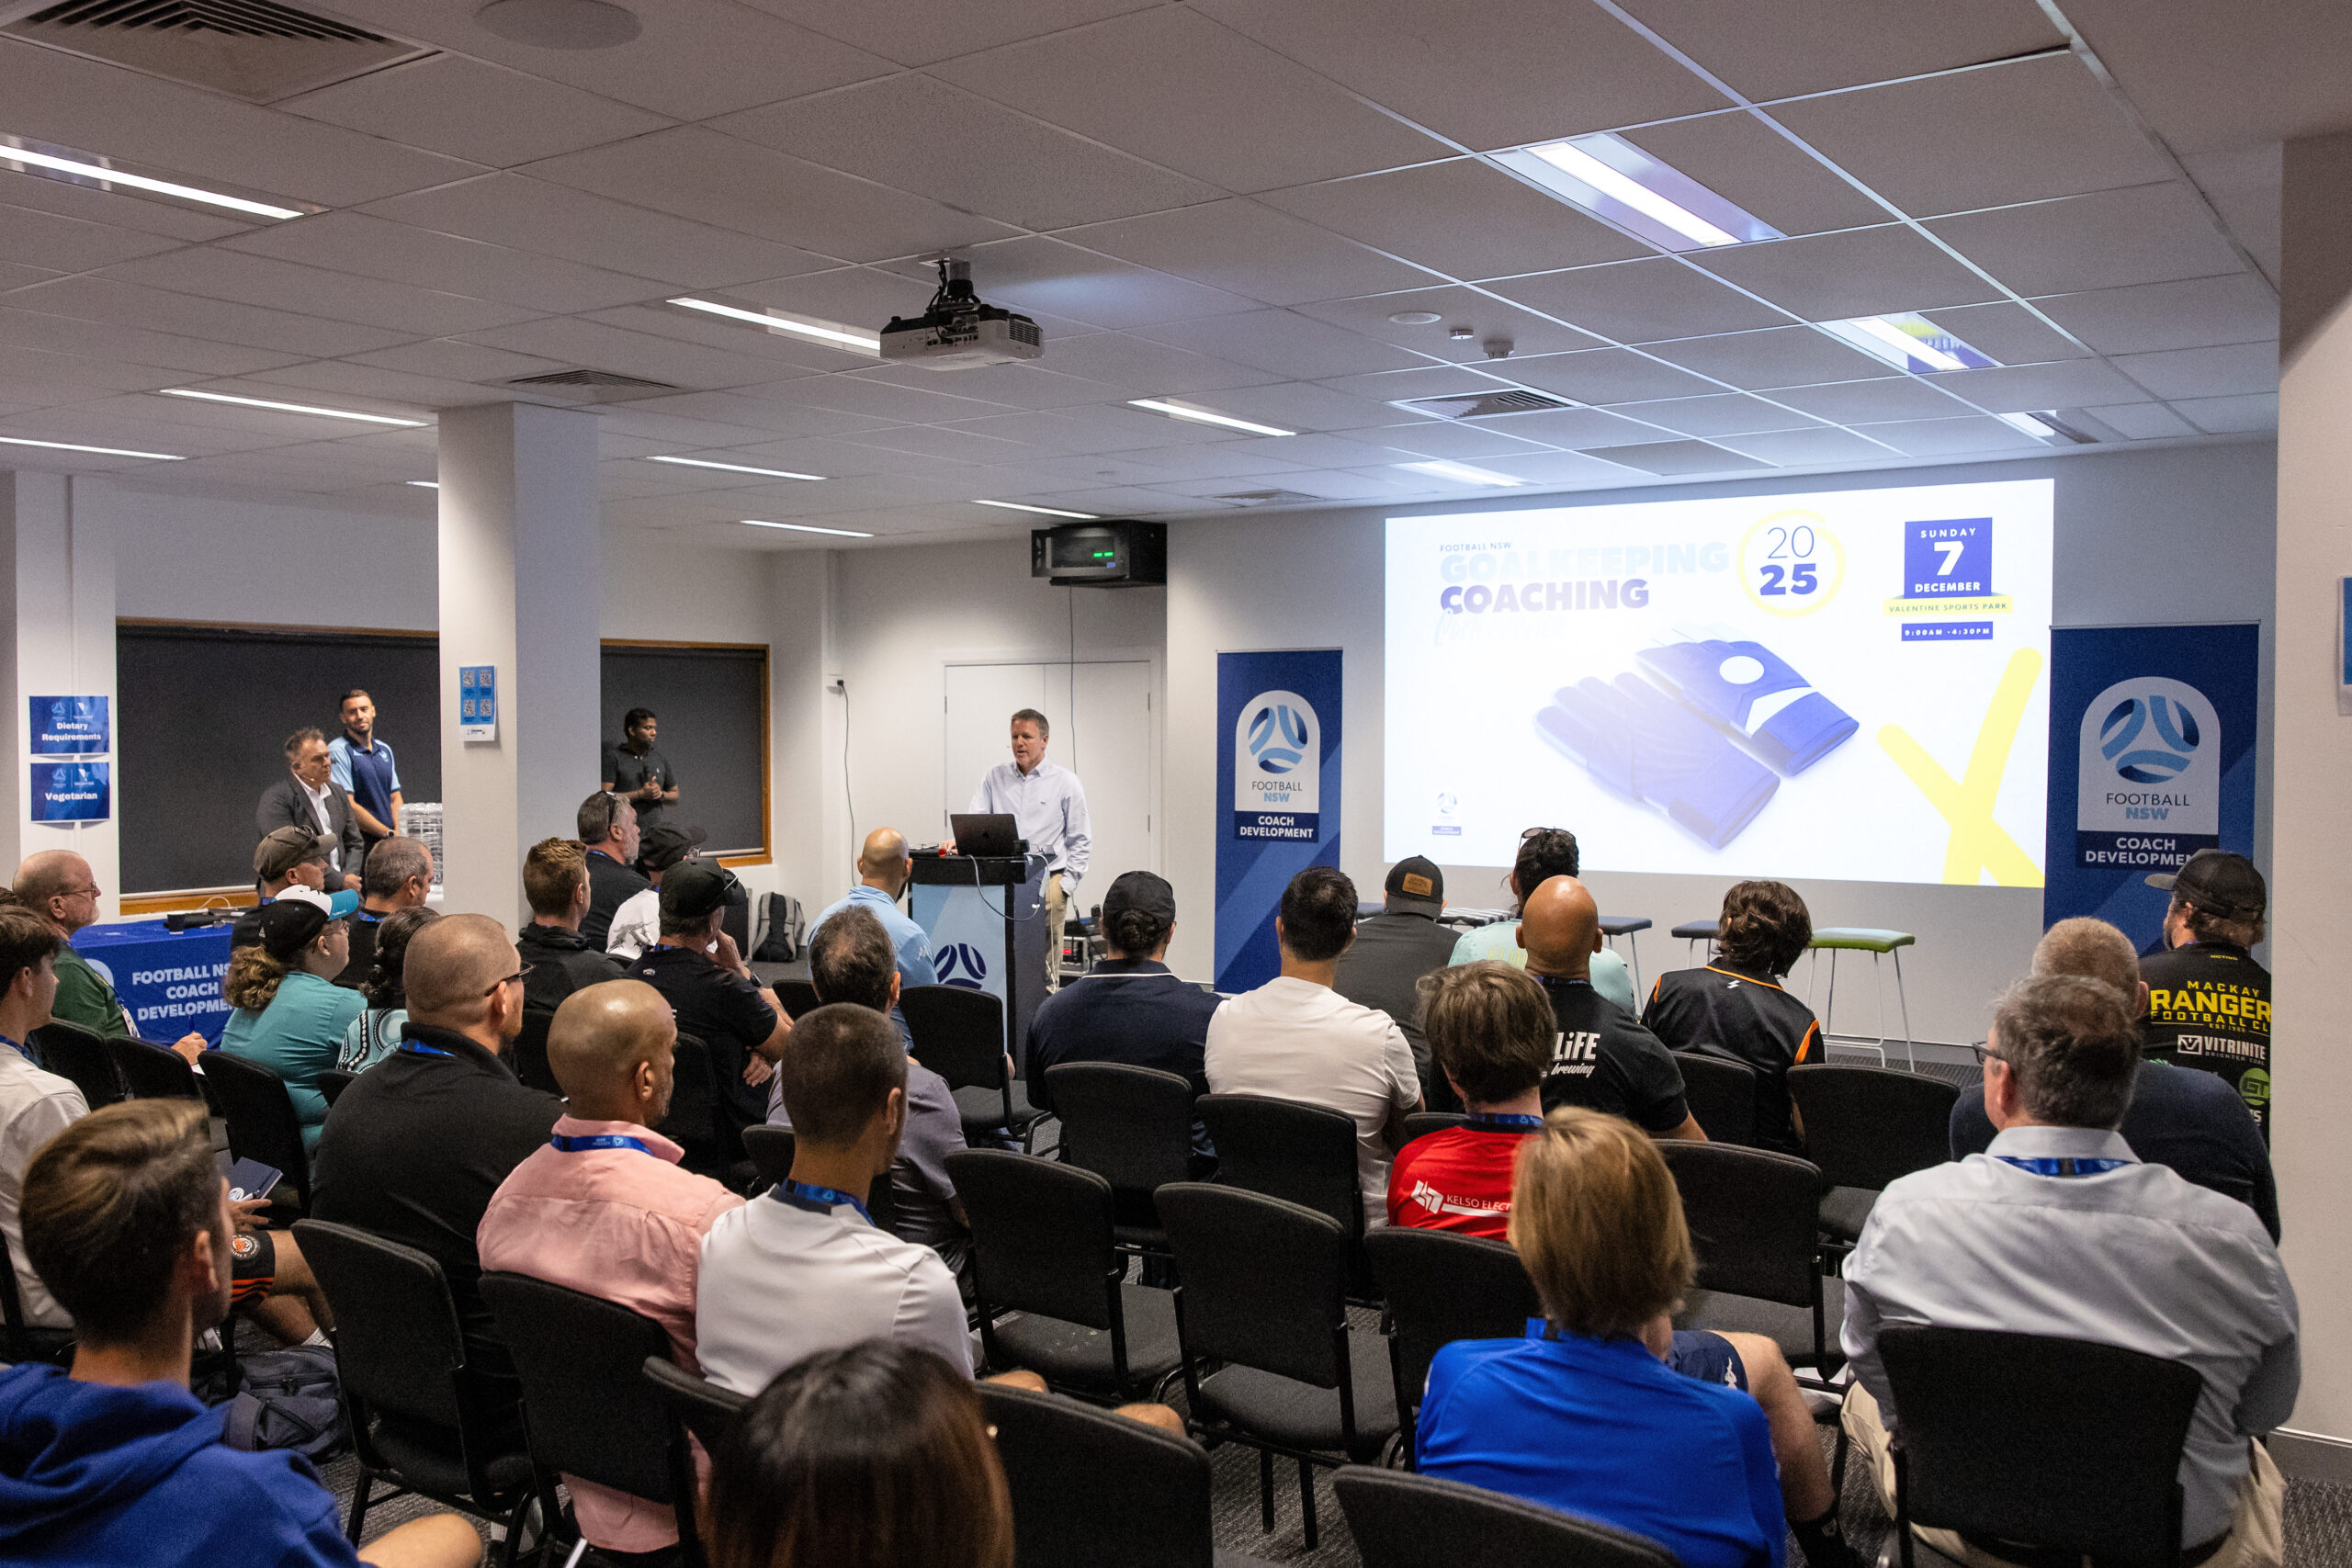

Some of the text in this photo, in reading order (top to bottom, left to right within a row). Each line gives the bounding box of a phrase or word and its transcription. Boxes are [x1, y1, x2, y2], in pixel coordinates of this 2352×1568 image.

[1920, 527, 1976, 538] SUNDAY
[1440, 541, 1512, 552] FOOTBALL NSW
[1767, 525, 1815, 558] 20
[1440, 541, 1729, 583] GOALKEEPING
[1934, 540, 1964, 576] 7
[1759, 563, 1818, 596] 25
[1915, 581, 1981, 593] DECEMBER
[1440, 578, 1649, 615] COACHING
[1889, 604, 1940, 613] VALENTINE
[56, 722, 88, 731] Dietary
[41, 733, 102, 742] Requirements
[1251, 781, 1303, 792] FOOTBALL
[45, 792, 98, 802] Vegetarian
[1263, 793, 1291, 803] NSW
[2106, 793, 2190, 807] FOOTBALL
[2125, 807, 2170, 820] NSW
[1258, 816, 1295, 826] COACH
[1240, 827, 1314, 839] DEVELOPMENT
[2116, 838, 2177, 851] COACH
[132, 964, 210, 985] FOOTBALL
[165, 982, 219, 999] COACH
[2187, 980, 2260, 998] MACKAY
[138, 998, 232, 1021] DEVELOPME
[2151, 1010, 2247, 1027] FOOTBALL
[2203, 1035, 2267, 1061] VITRINITE
[1551, 1062, 1596, 1078] brewing
[1446, 1194, 1480, 1209] KELSO
